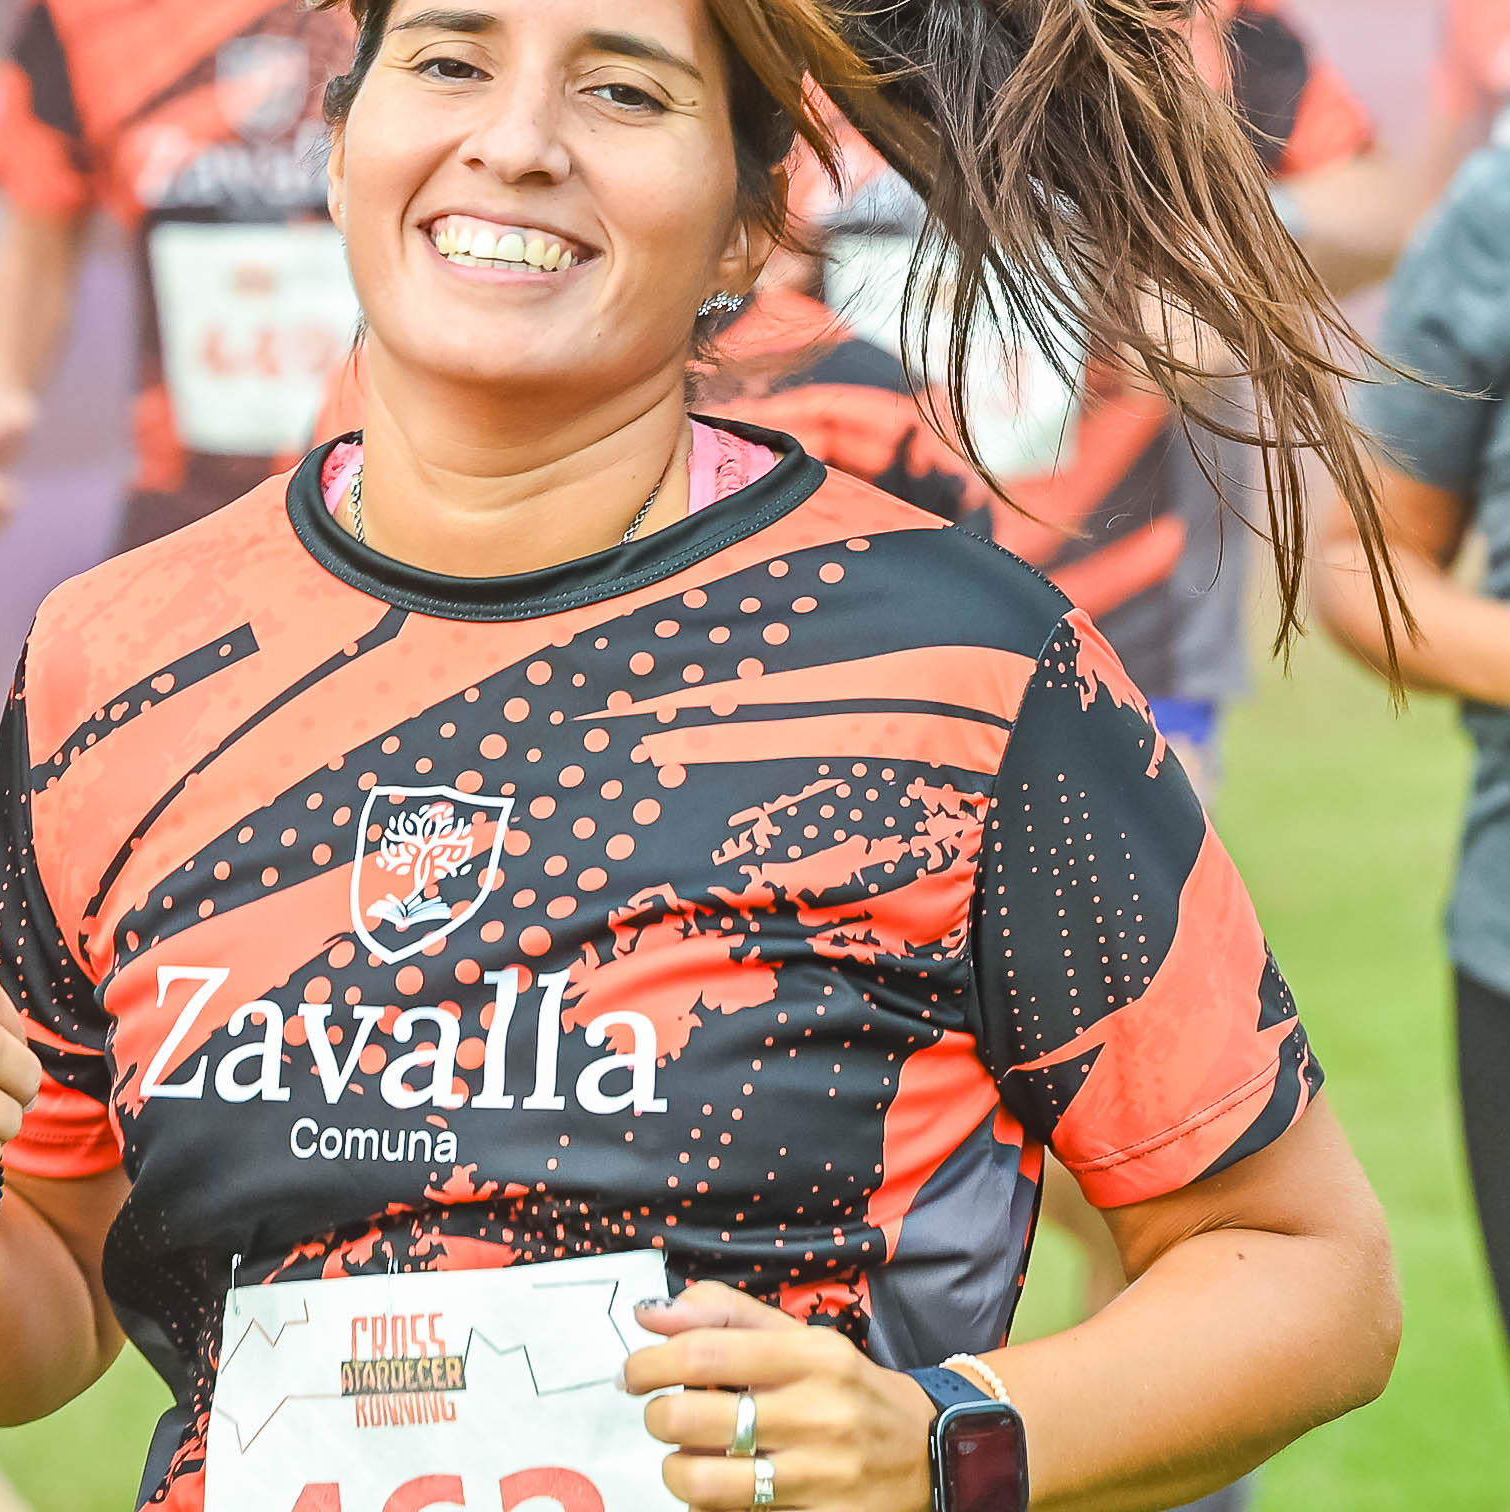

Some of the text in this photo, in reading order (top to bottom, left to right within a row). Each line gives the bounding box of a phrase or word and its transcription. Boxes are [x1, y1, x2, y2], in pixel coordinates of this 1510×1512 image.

[139, 965, 669, 1115] Zavalla
[289, 1116, 458, 1164] Comuna
[351, 1312, 447, 1360] CROSS
[341, 1356, 465, 1395] ATARDECER
[354, 1391, 458, 1428] RUNNING
